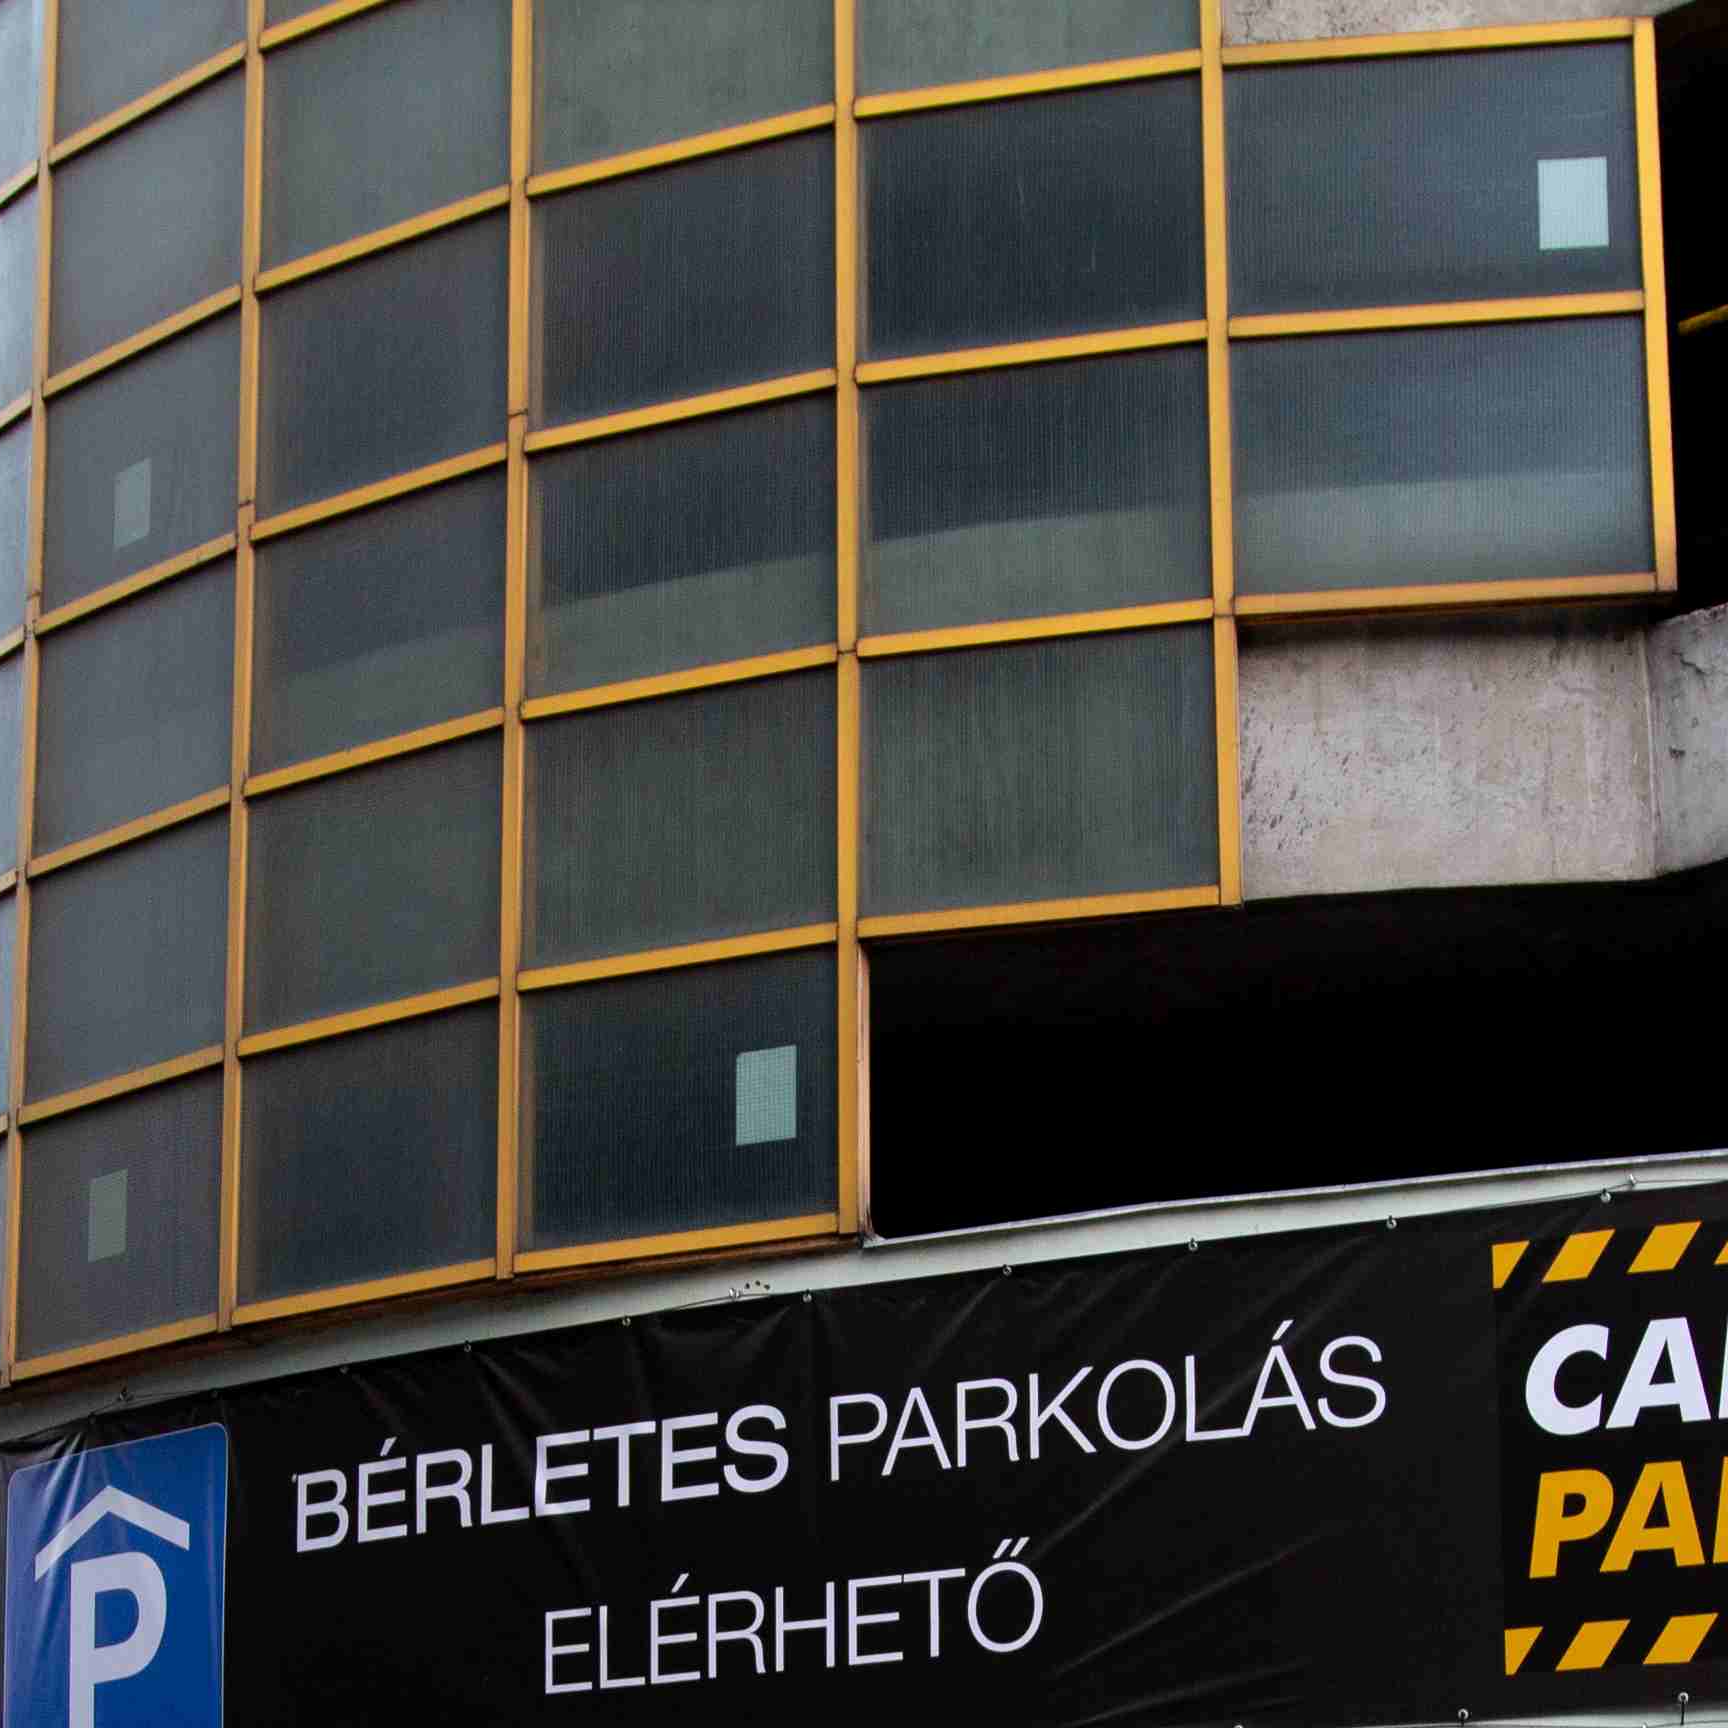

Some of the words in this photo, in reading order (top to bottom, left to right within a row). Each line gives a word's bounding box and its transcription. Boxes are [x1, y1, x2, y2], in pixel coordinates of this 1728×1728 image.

[295, 1401, 789, 1553] BÉRLETES
[828, 1320, 1388, 1482] PARKOLÁS
[543, 1535, 1045, 1695] ELÉRHETŐ
